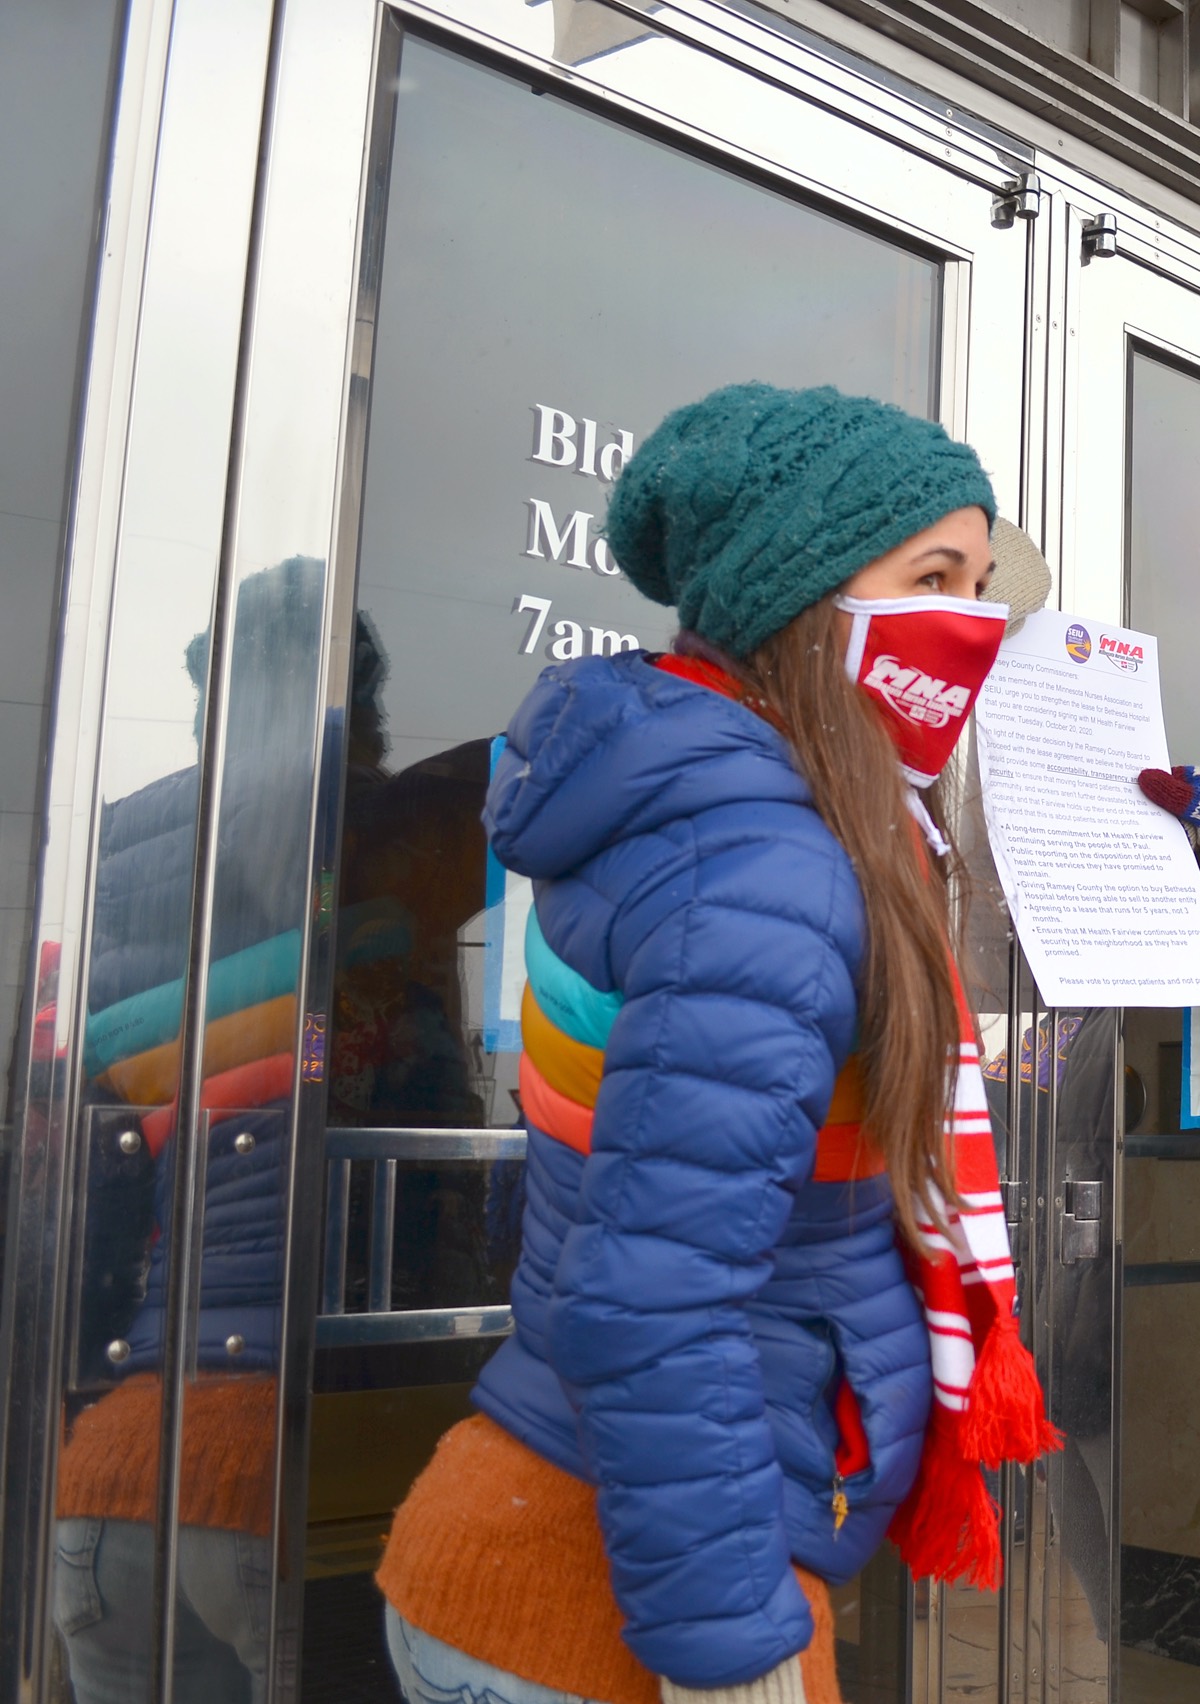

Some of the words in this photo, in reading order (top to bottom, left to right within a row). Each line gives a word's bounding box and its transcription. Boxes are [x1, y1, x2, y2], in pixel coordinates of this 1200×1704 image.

[532, 403, 634, 482] Bld
[518, 594, 640, 660] 7am
[1067, 627, 1084, 638] SEIU
[1100, 637, 1144, 659] MNA
[1010, 659, 1034, 672] County
[865, 660, 972, 709] MNA
[1007, 676, 1037, 687] members
[1037, 680, 1045, 688] of
[1045, 682, 1055, 691] the
[1055, 683, 1083, 696] Minnesota
[1084, 690, 1103, 701] Nurses
[1103, 694, 1132, 707] Association
[1004, 689, 1020, 698] urge
[1020, 691, 1032, 700] you
[1033, 692, 1040, 700] to
[1040, 695, 1070, 706] strengthen
[1070, 700, 1080, 708] the
[1080, 702, 1095, 711] lease
[1095, 704, 1103, 713] for
[1103, 706, 1128, 718] Bethesda
[1128, 712, 1150, 722] Hospital
[984, 697, 997, 706] that
[998, 701, 1011, 709] you
[1011, 702, 1022, 710] are
[1023, 705, 1057, 718] considering
[1057, 711, 1077, 722] signing
[1096, 717, 1113, 727] Health
[1114, 720, 1135, 731] Fairview
[1045, 720, 1068, 731] October
[993, 728, 1007, 738] light
[1007, 730, 1014, 738] of
[1015, 731, 1025, 740] the
[1026, 733, 1041, 742] clear
[1041, 736, 1066, 746] decision
[1066, 740, 1074, 749] by
[1074, 741, 1083, 750] the
[1084, 743, 1106, 755] Ramsey
[1107, 747, 1126, 759] County
[1126, 750, 1143, 760] Board
[988, 767, 1014, 778] security
[1011, 823, 1046, 834] long-term
[1047, 829, 1090, 837] commitment
[1134, 832, 1163, 840] Fairview
[1007, 835, 1046, 847] continuing
[1046, 839, 1073, 849] serving
[1073, 840, 1086, 848] the
[1087, 841, 1112, 849] people
[1112, 841, 1120, 849] of
[1010, 846, 1033, 855] Public
[1034, 850, 1068, 859] reporting
[1079, 851, 1092, 859] the
[1093, 852, 1132, 860] disposition
[1133, 852, 1141, 860] of
[1141, 853, 1158, 862] jobs
[1013, 857, 1037, 866] health
[1054, 861, 1085, 869] services
[1085, 862, 1102, 871] they
[1103, 862, 1121, 870] have
[1122, 863, 1155, 871] promised
[1020, 880, 1045, 891] Giving
[1045, 881, 1075, 892] Ramsey
[1076, 883, 1102, 893] County
[1117, 884, 1140, 893] option
[1149, 884, 1163, 893] buy
[1163, 884, 1196, 893] Bethesda
[1024, 891, 1055, 900] Hospital
[1055, 893, 1079, 901] before
[1079, 894, 1102, 903] being
[1102, 894, 1118, 902] able
[1178, 896, 1197, 904] entity
[1028, 903, 1062, 913] Agreeing
[1077, 905, 1097, 913] lease
[1131, 905, 1142, 914] for
[1183, 906, 1189, 914] 3
[1035, 925, 1063, 934] Ensure
[1087, 927, 1111, 935] Health
[1111, 928, 1141, 936] Fairview
[1143, 928, 1177, 936] continues
[1040, 937, 1070, 946] security
[1079, 938, 1092, 946] the
[1093, 938, 1143, 947] neighborhood
[1153, 939, 1169, 948] they
[1058, 976, 1084, 984] Please
[1111, 978, 1137, 986] protect
[1137, 978, 1165, 986] patients
[1167, 977, 1181, 985] and
